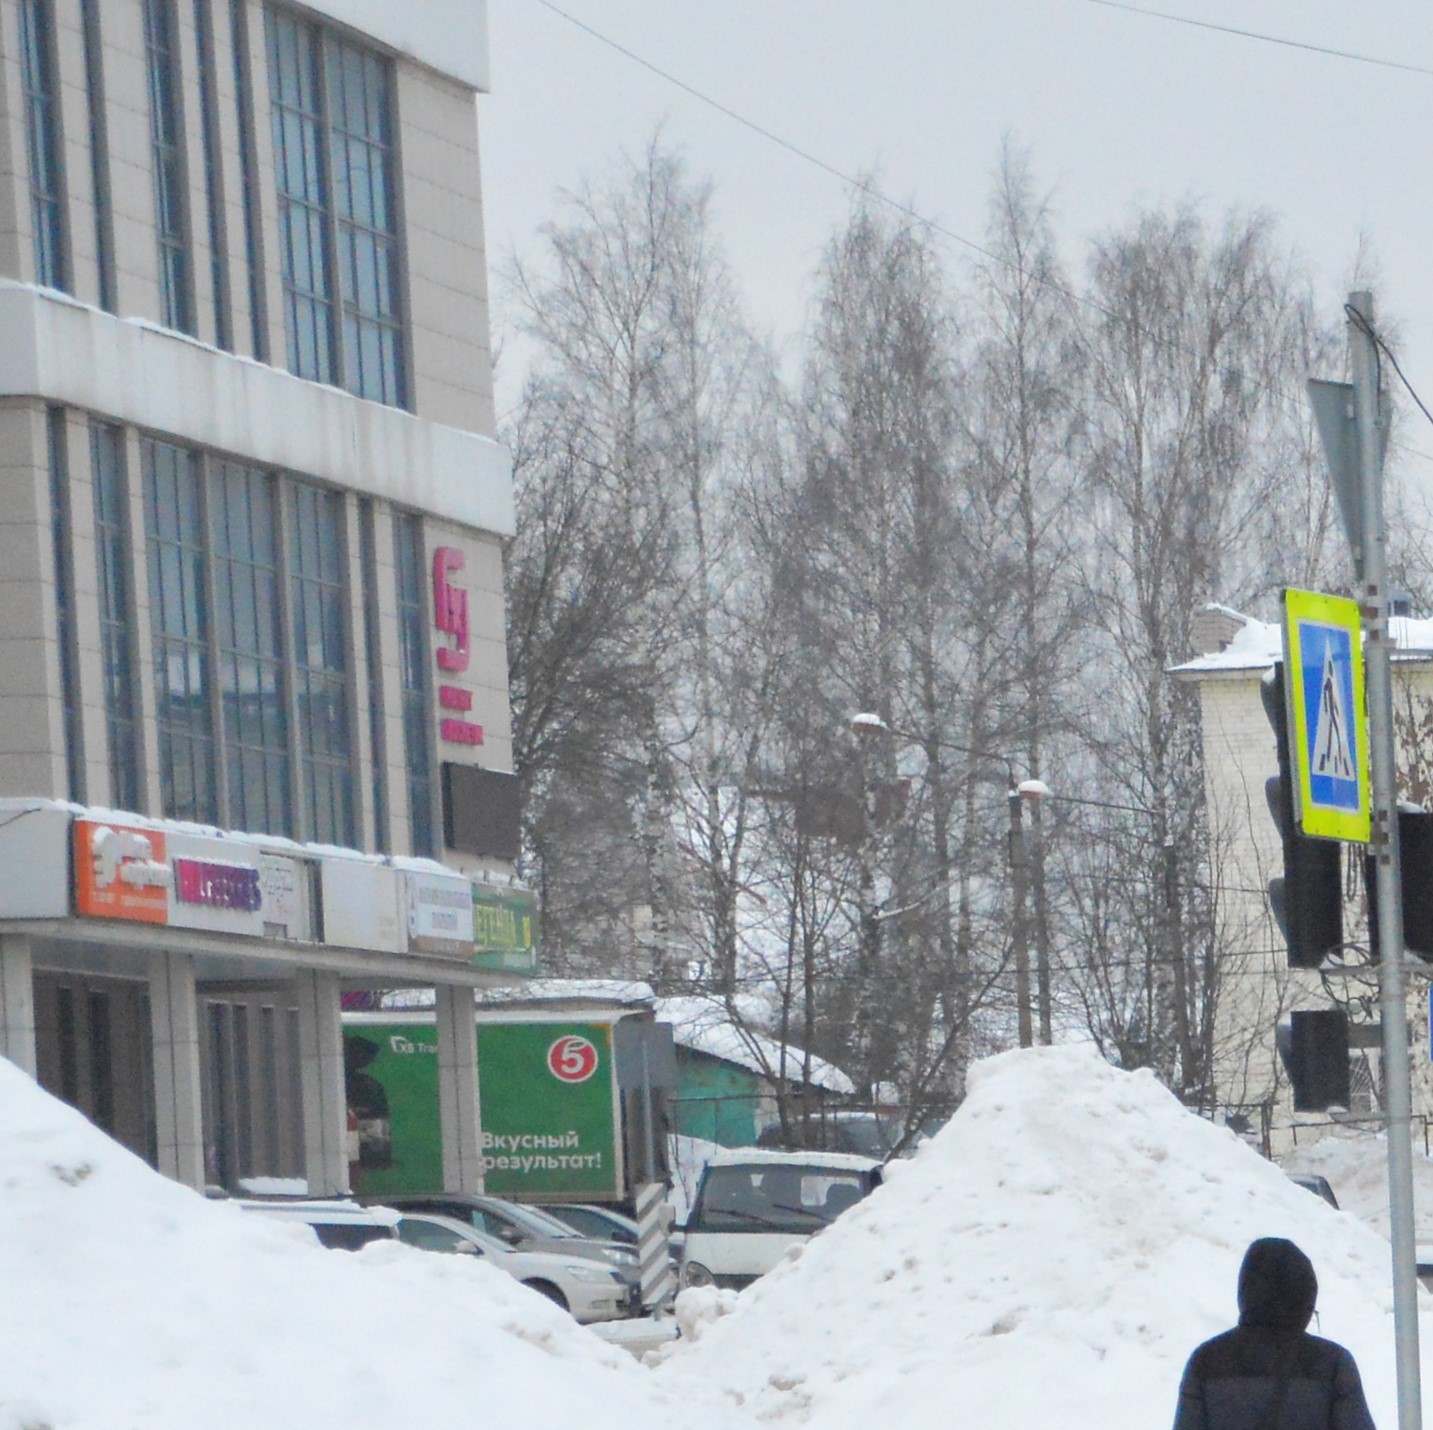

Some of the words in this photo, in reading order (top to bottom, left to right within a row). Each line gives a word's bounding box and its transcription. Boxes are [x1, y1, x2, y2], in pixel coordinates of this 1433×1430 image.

[561, 1038, 588, 1074] 5
[481, 1130, 579, 1153] Вкусный
[481, 1152, 602, 1174] результат!
